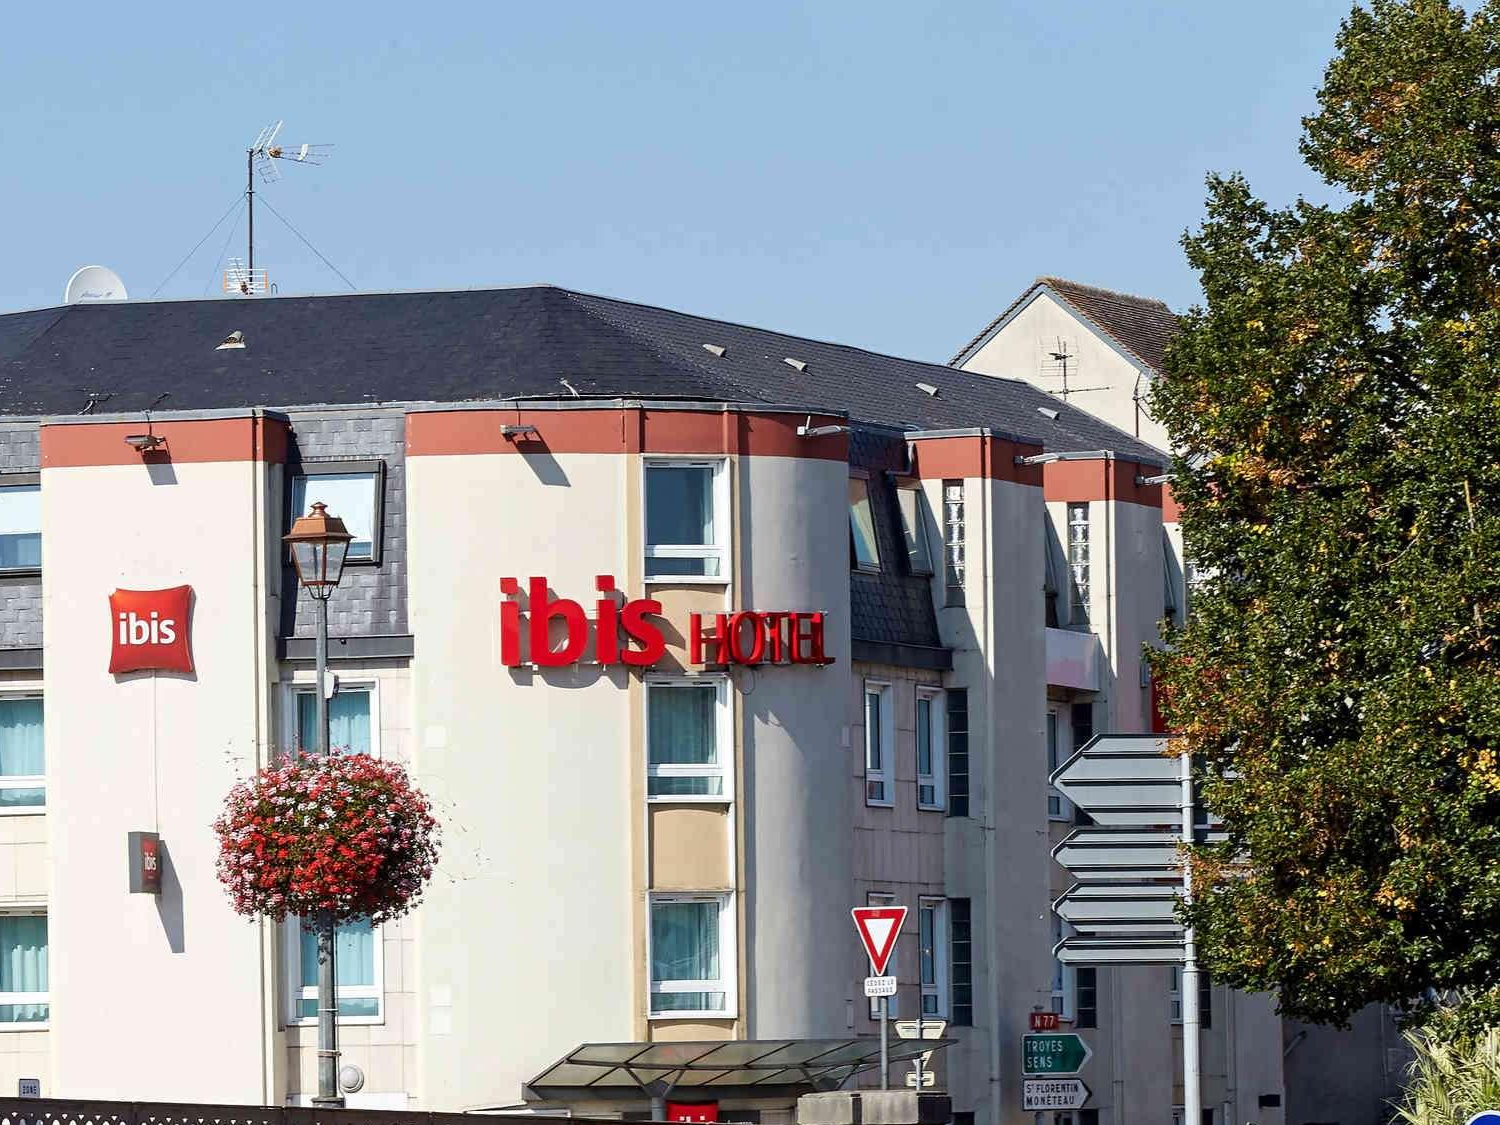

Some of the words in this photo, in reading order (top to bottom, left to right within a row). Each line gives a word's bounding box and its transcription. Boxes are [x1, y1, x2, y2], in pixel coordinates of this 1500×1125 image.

[500, 575, 666, 667] ibis
[690, 611, 836, 666] HOTEL
[119, 611, 176, 645] ibis
[144, 851, 157, 871] ibis
[1034, 1015, 1041, 1027] N
[1043, 1015, 1055, 1027] 77
[1026, 1040, 1063, 1052] TROYES
[1027, 1056, 1053, 1068] SENS
[1035, 1083, 1079, 1093] FLORENTIN
[1026, 1094, 1075, 1106] MONÉTEAU
